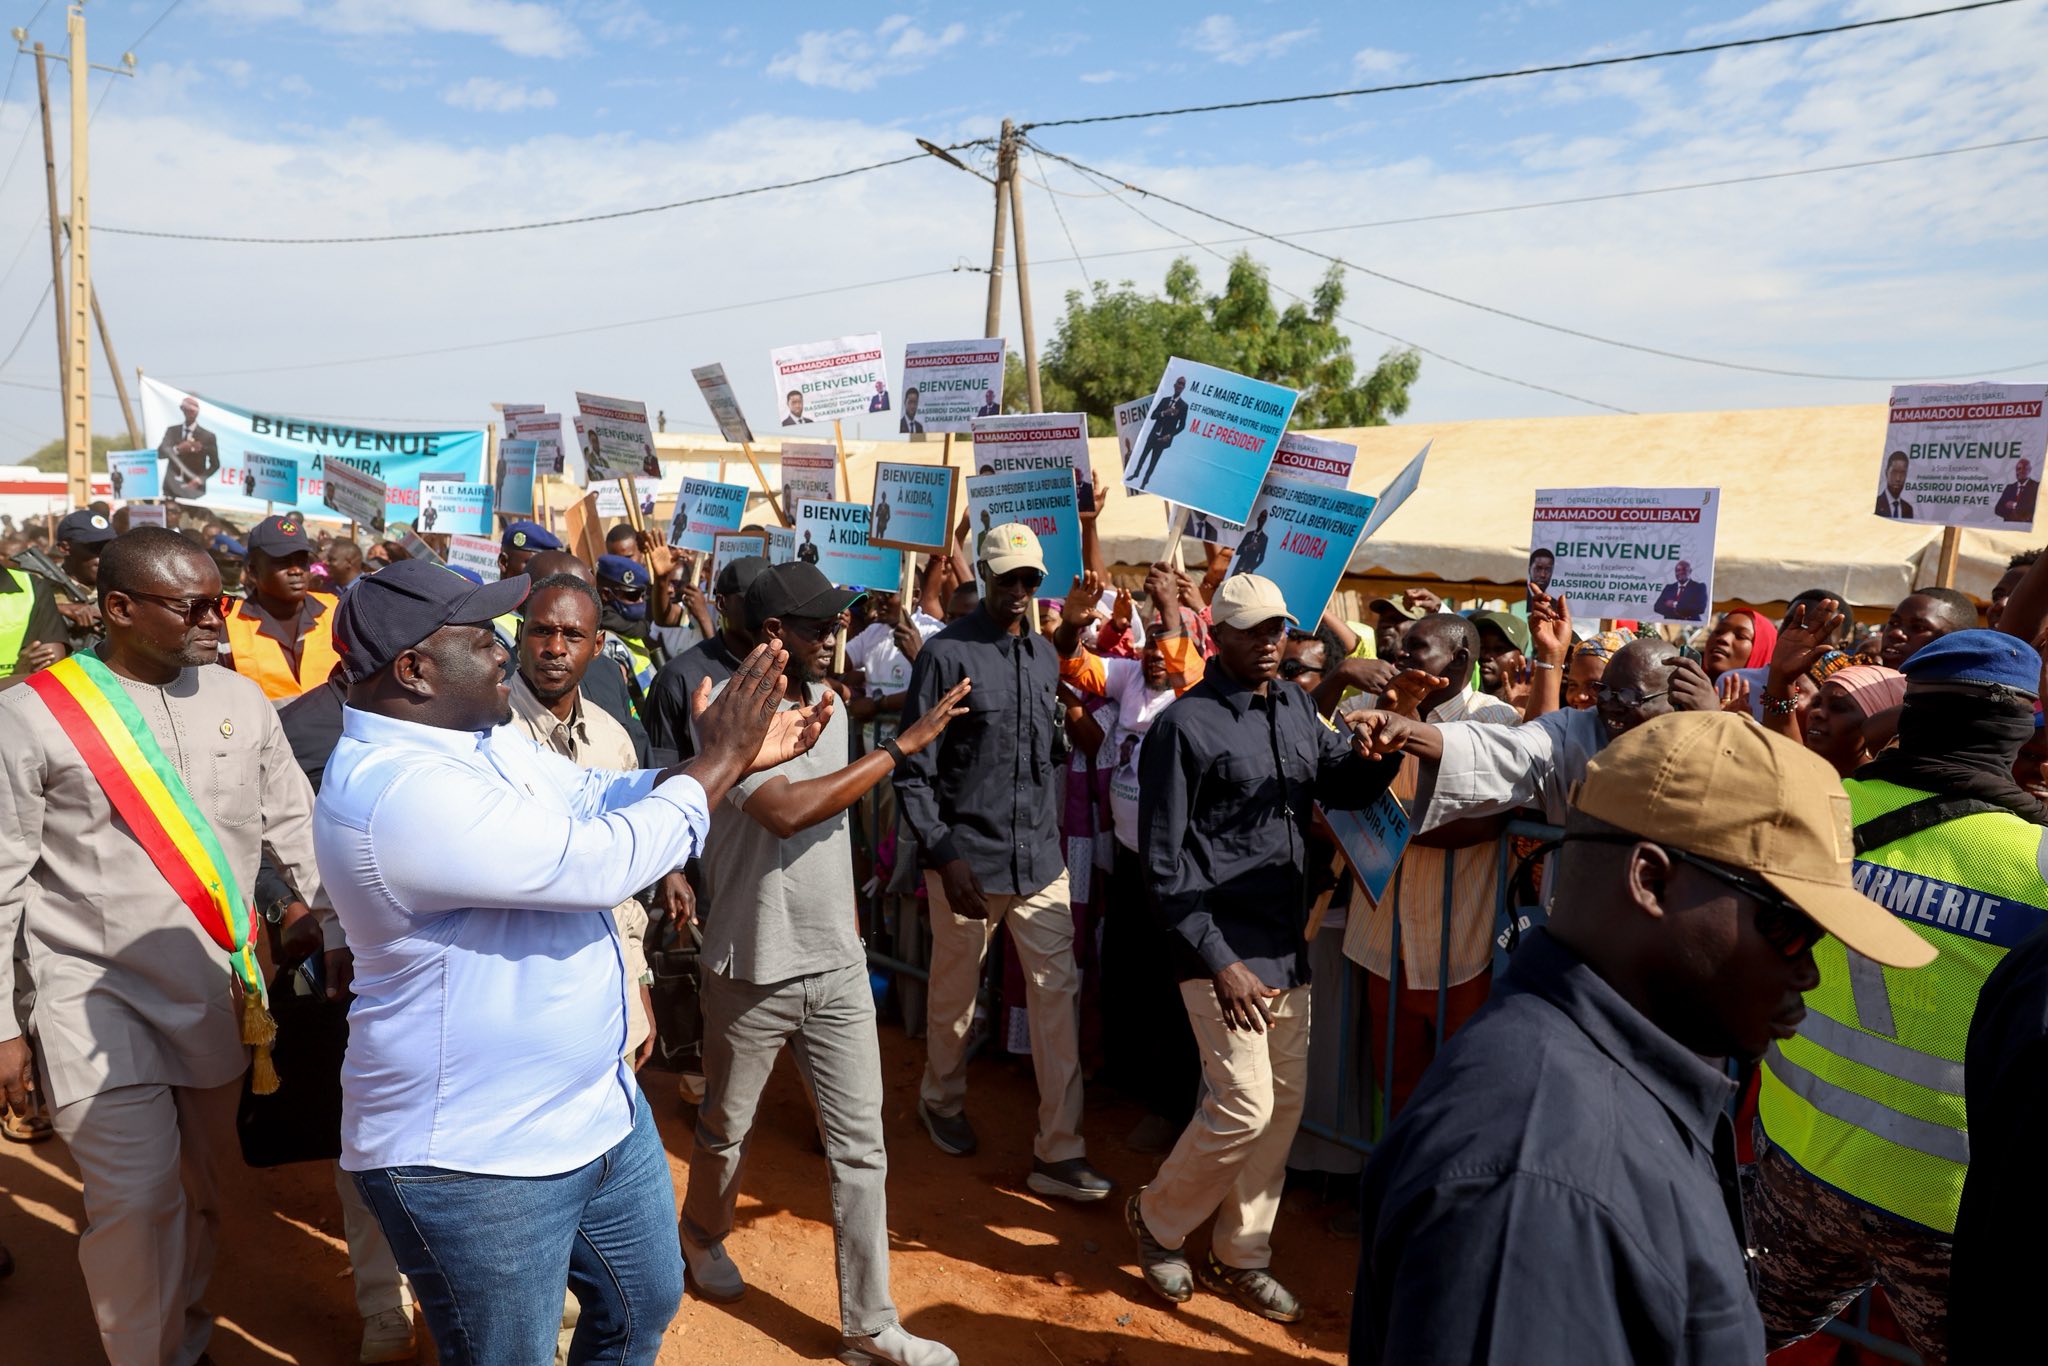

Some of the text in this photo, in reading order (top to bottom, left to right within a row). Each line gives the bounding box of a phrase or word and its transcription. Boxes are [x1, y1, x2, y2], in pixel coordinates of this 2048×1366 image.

[835, 351, 881, 366] COULIBALY
[955, 353, 998, 364] COULIBALY
[801, 372, 876, 394] BIENVENUE
[919, 378, 989, 393] BIENVENUE
[1190, 381, 1285, 419] M. LE MAIRE DE KIDIRA
[1190, 402, 1281, 436] EST HONORÉ PAR VOTRE VISITE
[1893, 403, 2040, 421] M.MAMADOU COULIBALY
[252, 415, 439, 457] BIENVENUE
[595, 427, 645, 443] BIENVENUE
[976, 429, 1079, 442] M.MAMADOU COULIBALY
[1189, 419, 1201, 434] M.
[1202, 423, 1214, 439] LE
[1214, 426, 1265, 454] PRÉSIDENT
[1909, 441, 2022, 460] BIENVENUE
[247, 454, 295, 468] BIENVENUE
[312, 449, 322, 471] À
[993, 456, 1073, 471] BIENVENUE
[1282, 454, 1349, 475] COULIBALY
[220, 468, 236, 485] LE
[882, 469, 945, 486] BIENVENUE
[442, 486, 454, 495] LE
[684, 482, 743, 502] BIENVENUE
[790, 479, 829, 493] BIENVENUE
[1905, 482, 2003, 493] BASSIROU DIOMAYE
[696, 499, 703, 514] À
[989, 495, 1071, 514] SOYEZ LA BIENVENUE
[1917, 495, 1989, 505] DIAKHAR FAYE
[1269, 505, 1358, 538] SOYEZ LA BIENVENUE
[1535, 510, 1698, 521] M.MAMADOU COULIBALY
[829, 525, 837, 543] À
[1280, 525, 1328, 560] À KIDIRA
[719, 541, 760, 553] BIENVENUE
[1555, 542, 1680, 560] BIENVENUE
[1551, 579, 1663, 592] BASSIROU DIOMAYE
[1564, 591, 1648, 603] DIAKHAR FAYE
[1853, 864, 2001, 938] ARMERIE
